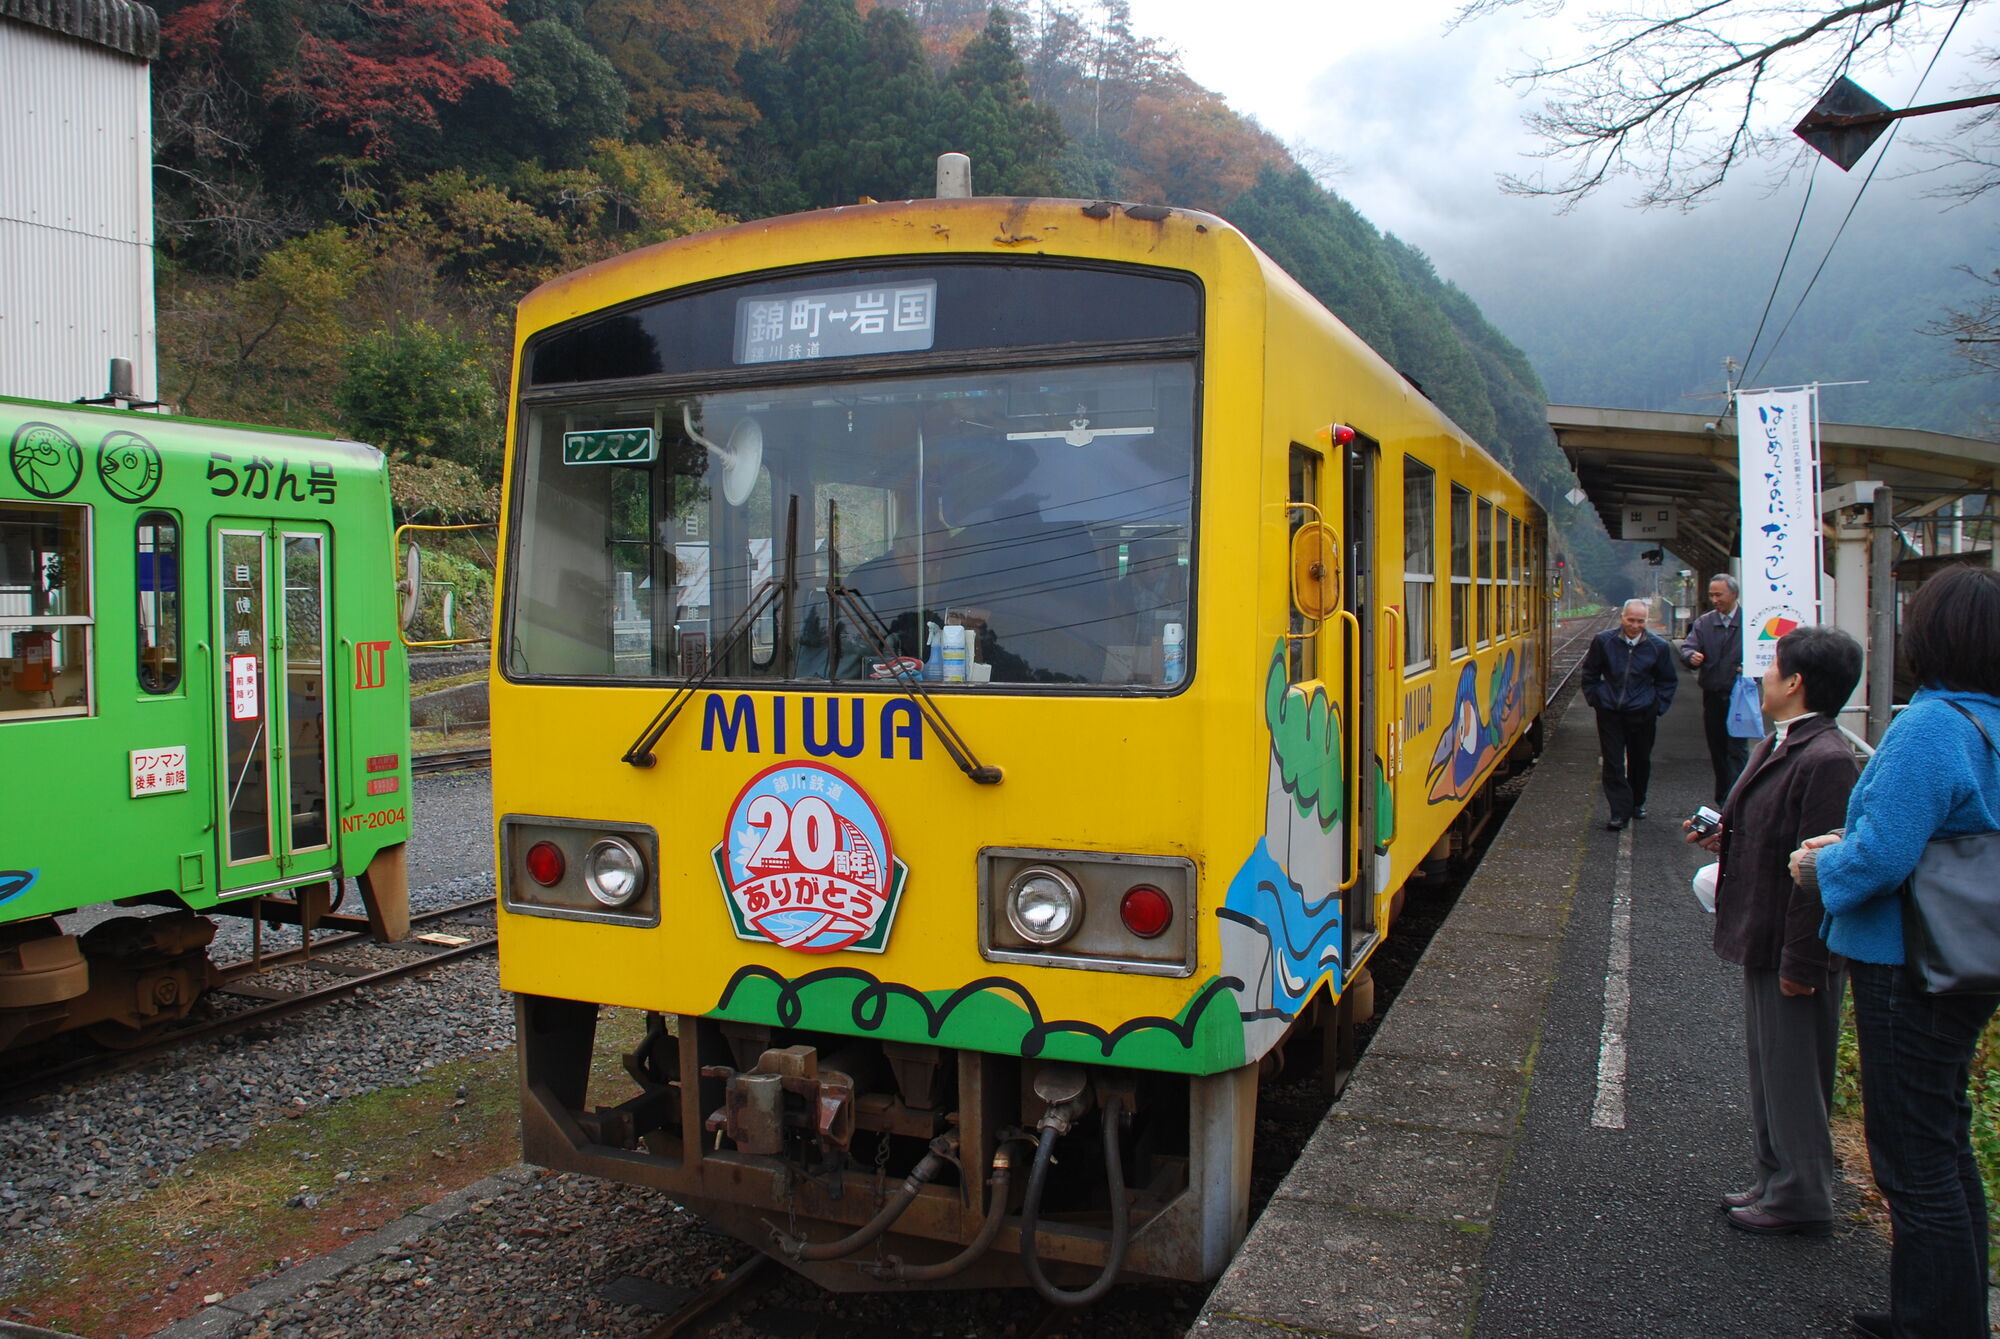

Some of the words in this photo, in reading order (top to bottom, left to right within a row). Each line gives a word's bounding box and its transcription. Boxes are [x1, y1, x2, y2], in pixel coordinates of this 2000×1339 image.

[751, 299, 826, 343] 錦町
[850, 288, 931, 335] 岩国
[567, 433, 649, 460] ワンマン
[206, 451, 338, 505] らかん号
[1631, 511, 1669, 522] 出口
[236, 676, 245, 714] 前降り
[246, 662, 255, 699] 後乗り
[701, 693, 923, 760] MIWA
[1404, 683, 1432, 744] MIWA
[135, 753, 185, 771] ワンマン
[135, 769, 185, 790] 後乗・前降
[772, 773, 845, 802] 錦川鉄道
[342, 807, 406, 834] NT-2004
[743, 876, 873, 920] ありがとう
